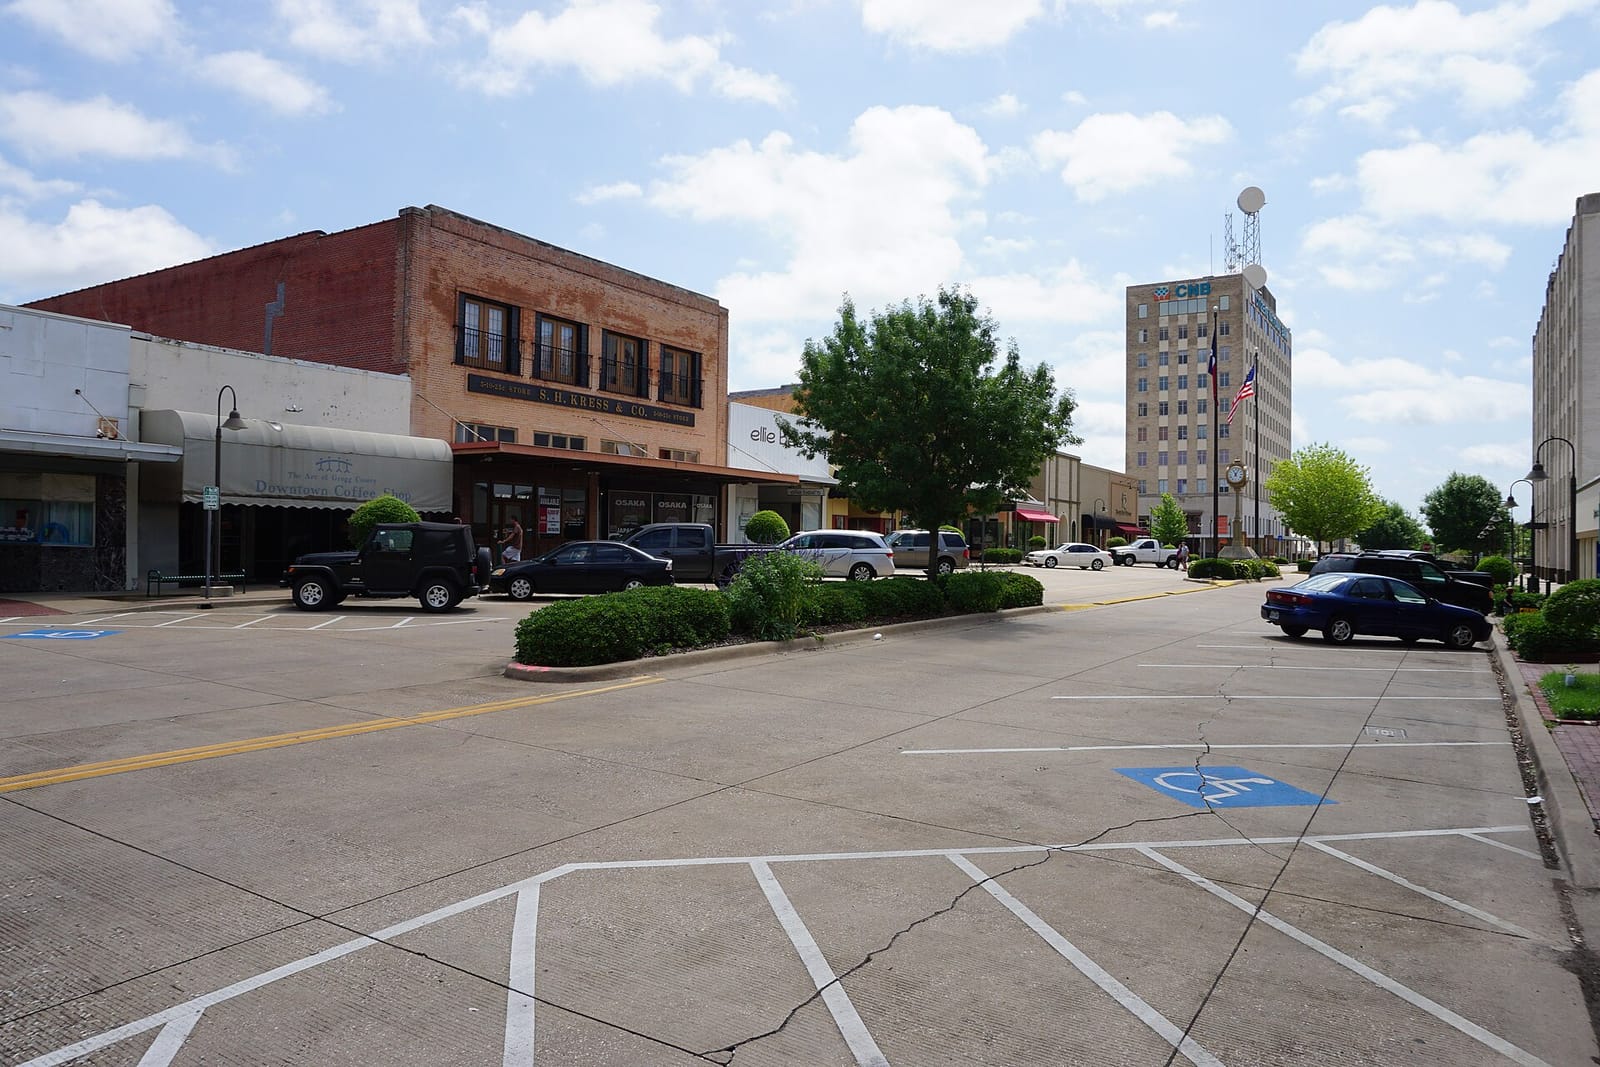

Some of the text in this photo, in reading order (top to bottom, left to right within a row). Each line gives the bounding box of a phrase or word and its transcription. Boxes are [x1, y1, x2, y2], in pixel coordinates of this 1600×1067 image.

[1175, 282, 1211, 298] CNB
[539, 389, 648, 417] S. H. KRESS & CO.
[750, 426, 776, 444] ellie
[288, 471, 300, 480] The
[255, 479, 328, 496] Downtown
[334, 485, 376, 499] Coffee
[615, 499, 646, 507] OSAKA
[658, 501, 687, 509] OSAKA
